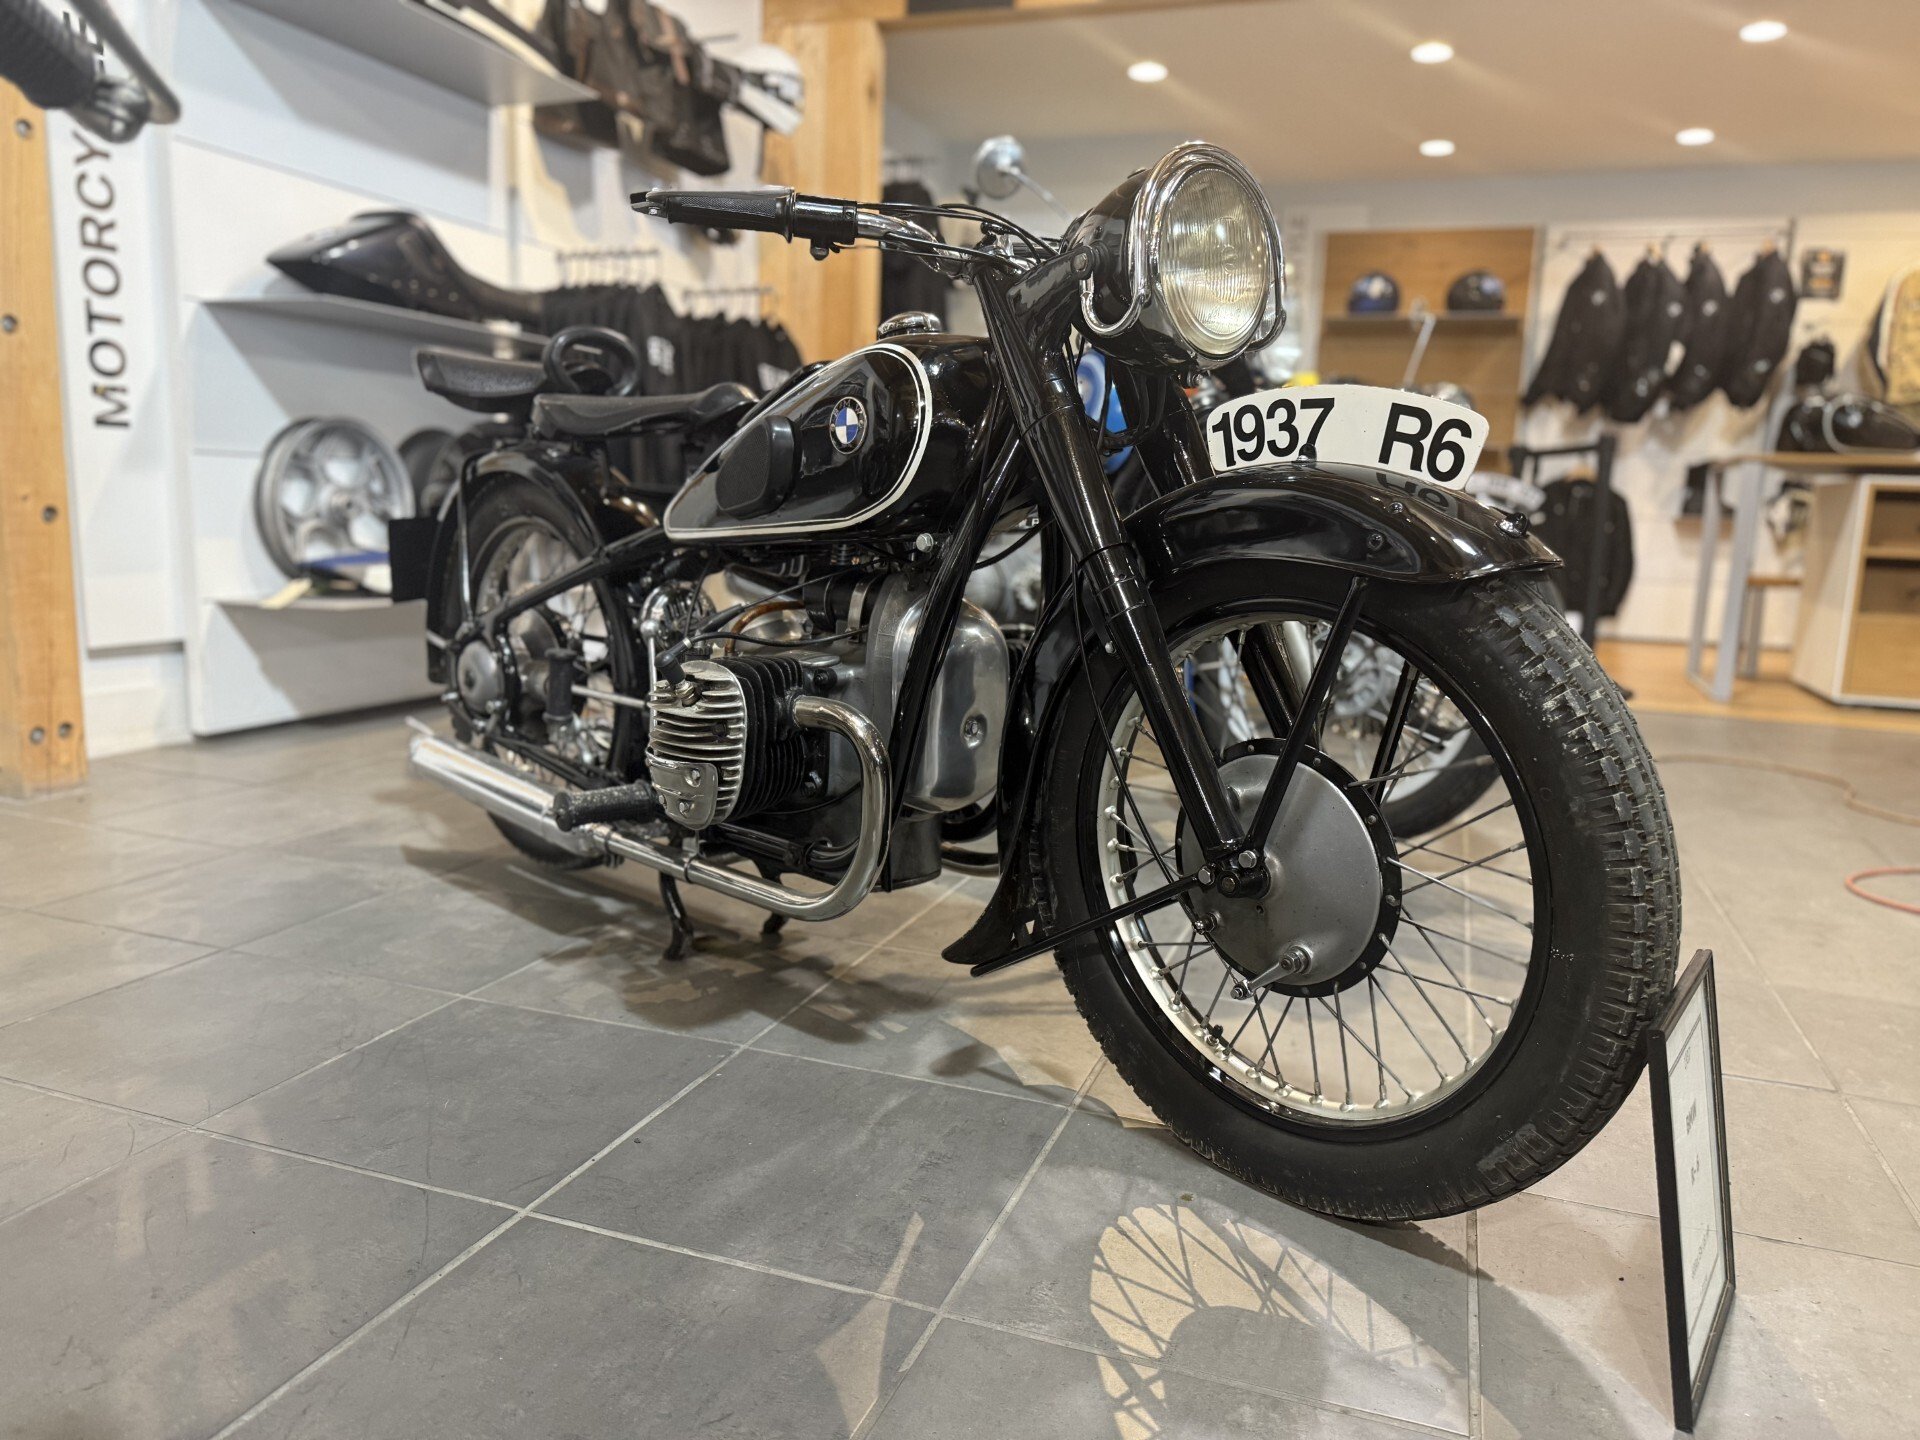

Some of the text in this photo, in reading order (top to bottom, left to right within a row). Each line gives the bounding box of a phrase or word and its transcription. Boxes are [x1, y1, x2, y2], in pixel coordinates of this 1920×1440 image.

[62, 9, 131, 429] MOTORCYE
[1211, 397, 1473, 483] 1937 R6
